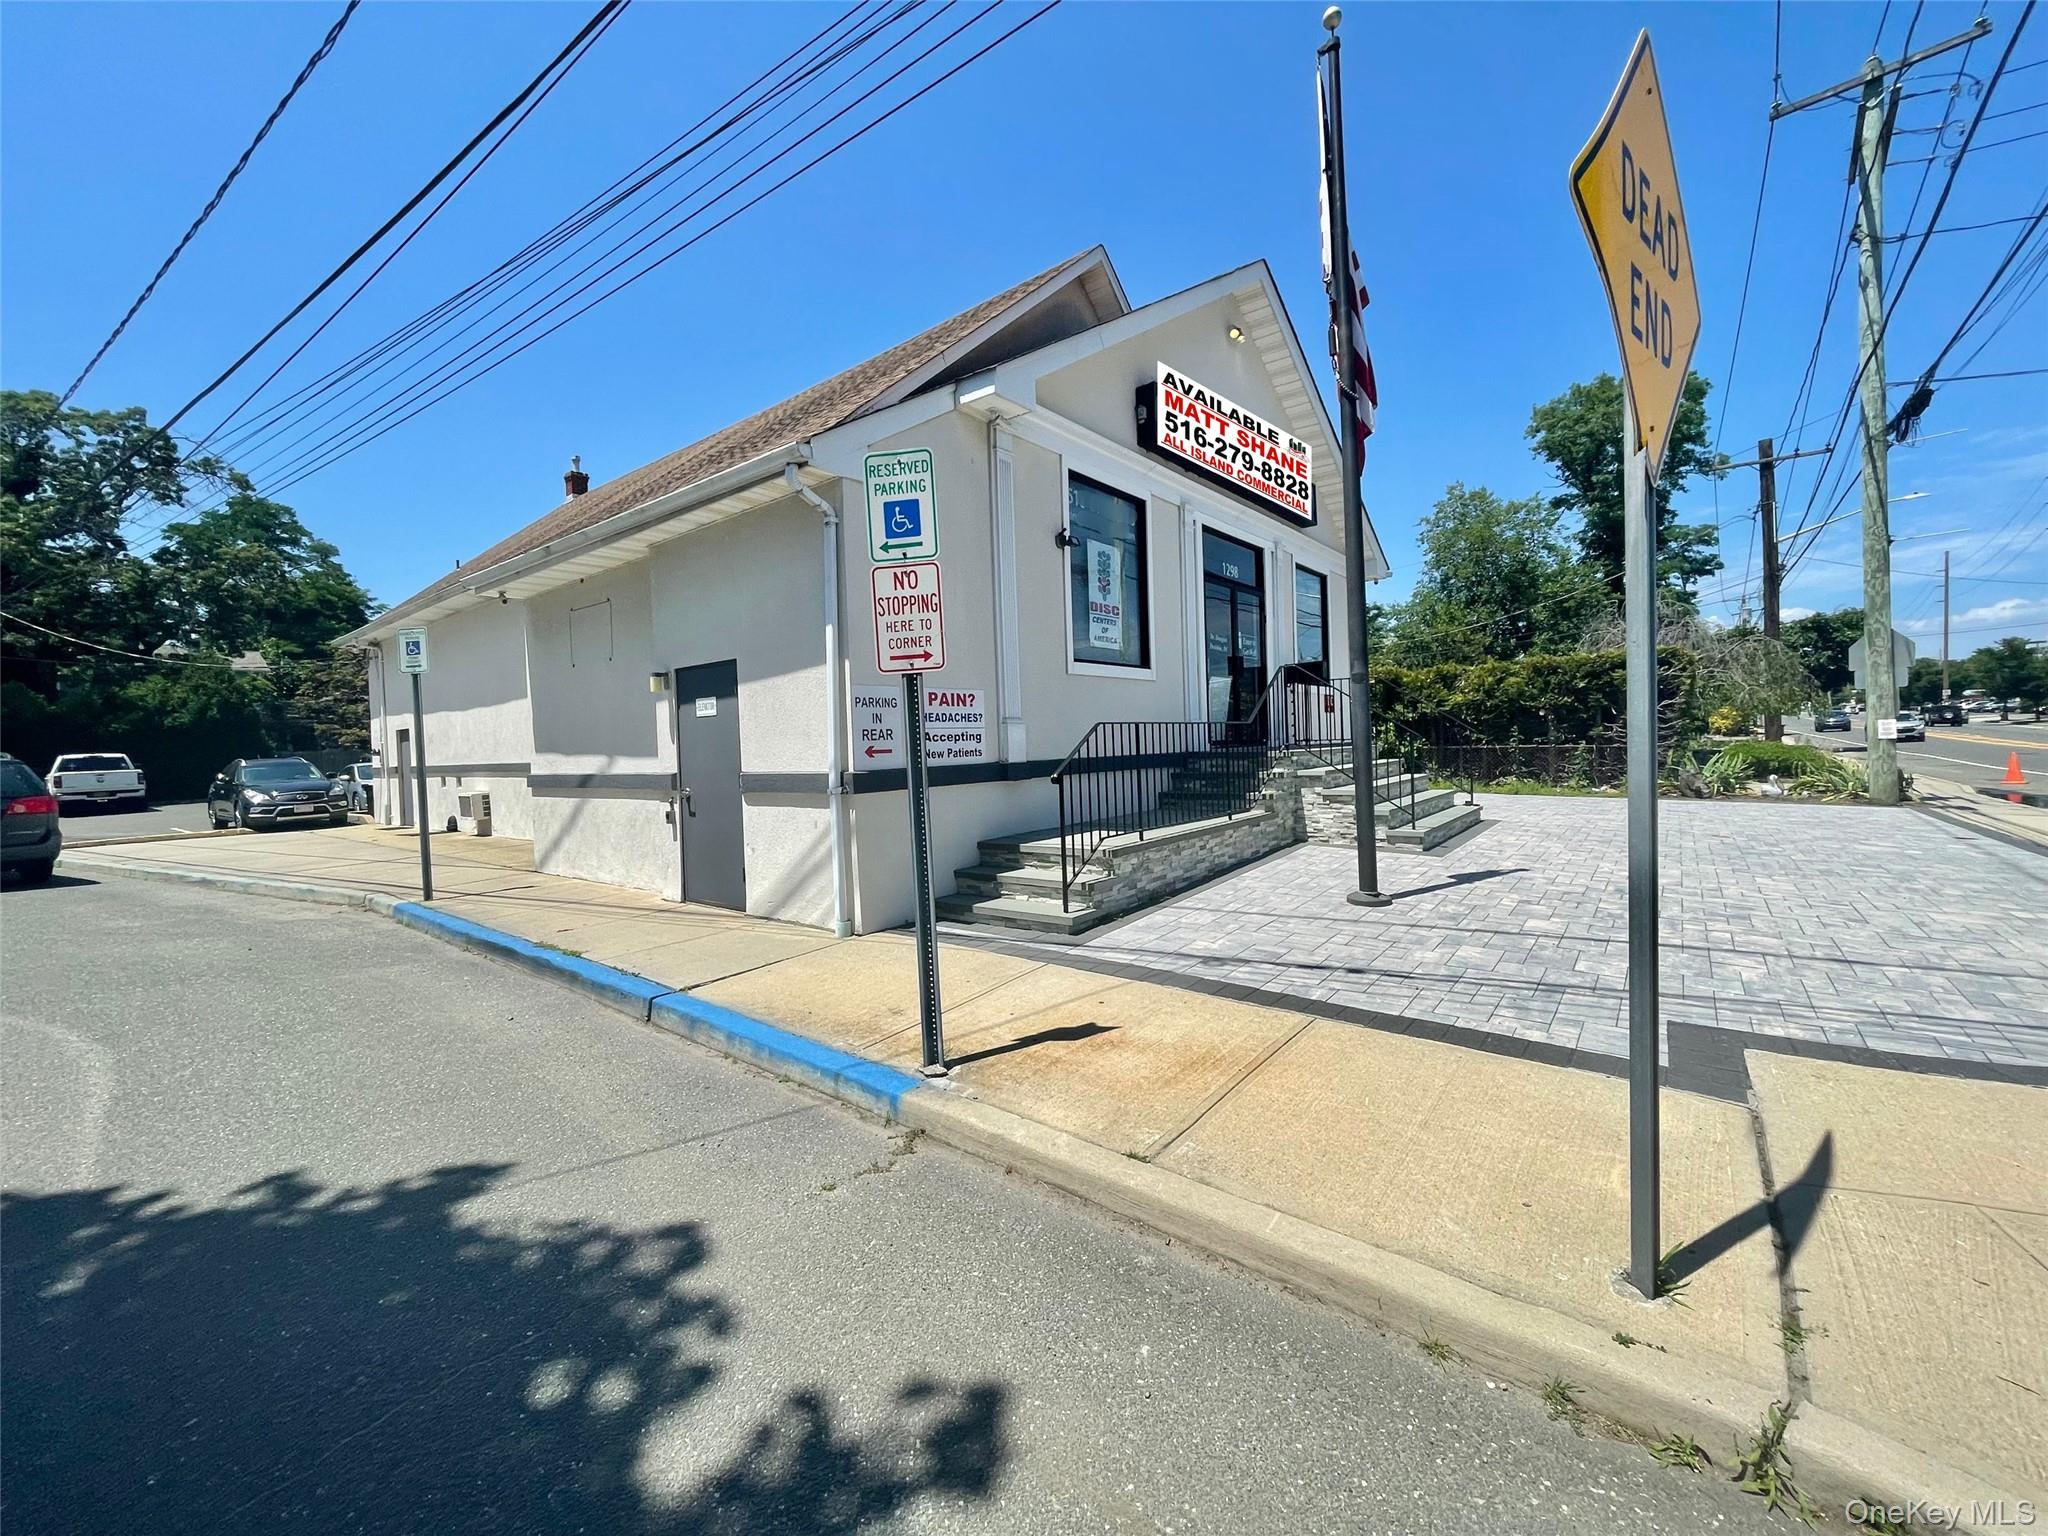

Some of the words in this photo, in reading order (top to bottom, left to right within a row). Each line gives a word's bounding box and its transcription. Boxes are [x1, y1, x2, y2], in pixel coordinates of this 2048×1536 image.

[1621, 138, 1679, 282] DEAD
[1630, 260, 1673, 369] END
[1162, 372, 1280, 446] AVAILABLE
[1164, 389, 1230, 437] MATT
[1236, 429, 1308, 480] SHANE
[1165, 410, 1309, 500] 516-279-8828
[869, 459, 929, 479] RESERVED
[1163, 432, 1188, 453] ALL
[1190, 445, 1234, 476] ISLAND
[1237, 469, 1308, 513] COMMERCIAL
[874, 478, 927, 497] PARKING
[893, 569, 918, 591] NO
[877, 593, 938, 617] STOPPING
[1090, 601, 1120, 616] DISC
[886, 620, 914, 633] HERE
[919, 618, 932, 631] TO
[1092, 616, 1117, 626] CENTERS
[888, 635, 932, 650] CORNER
[1094, 635, 1118, 644] AMERICA
[855, 697, 898, 709] PARKING
[928, 692, 976, 707] PAIN?
[872, 713, 882, 724] IN
[862, 728, 894, 741] REAR
[925, 731, 982, 744] Accepting
[926, 748, 945, 759] New
[947, 747, 983, 758] Patients
